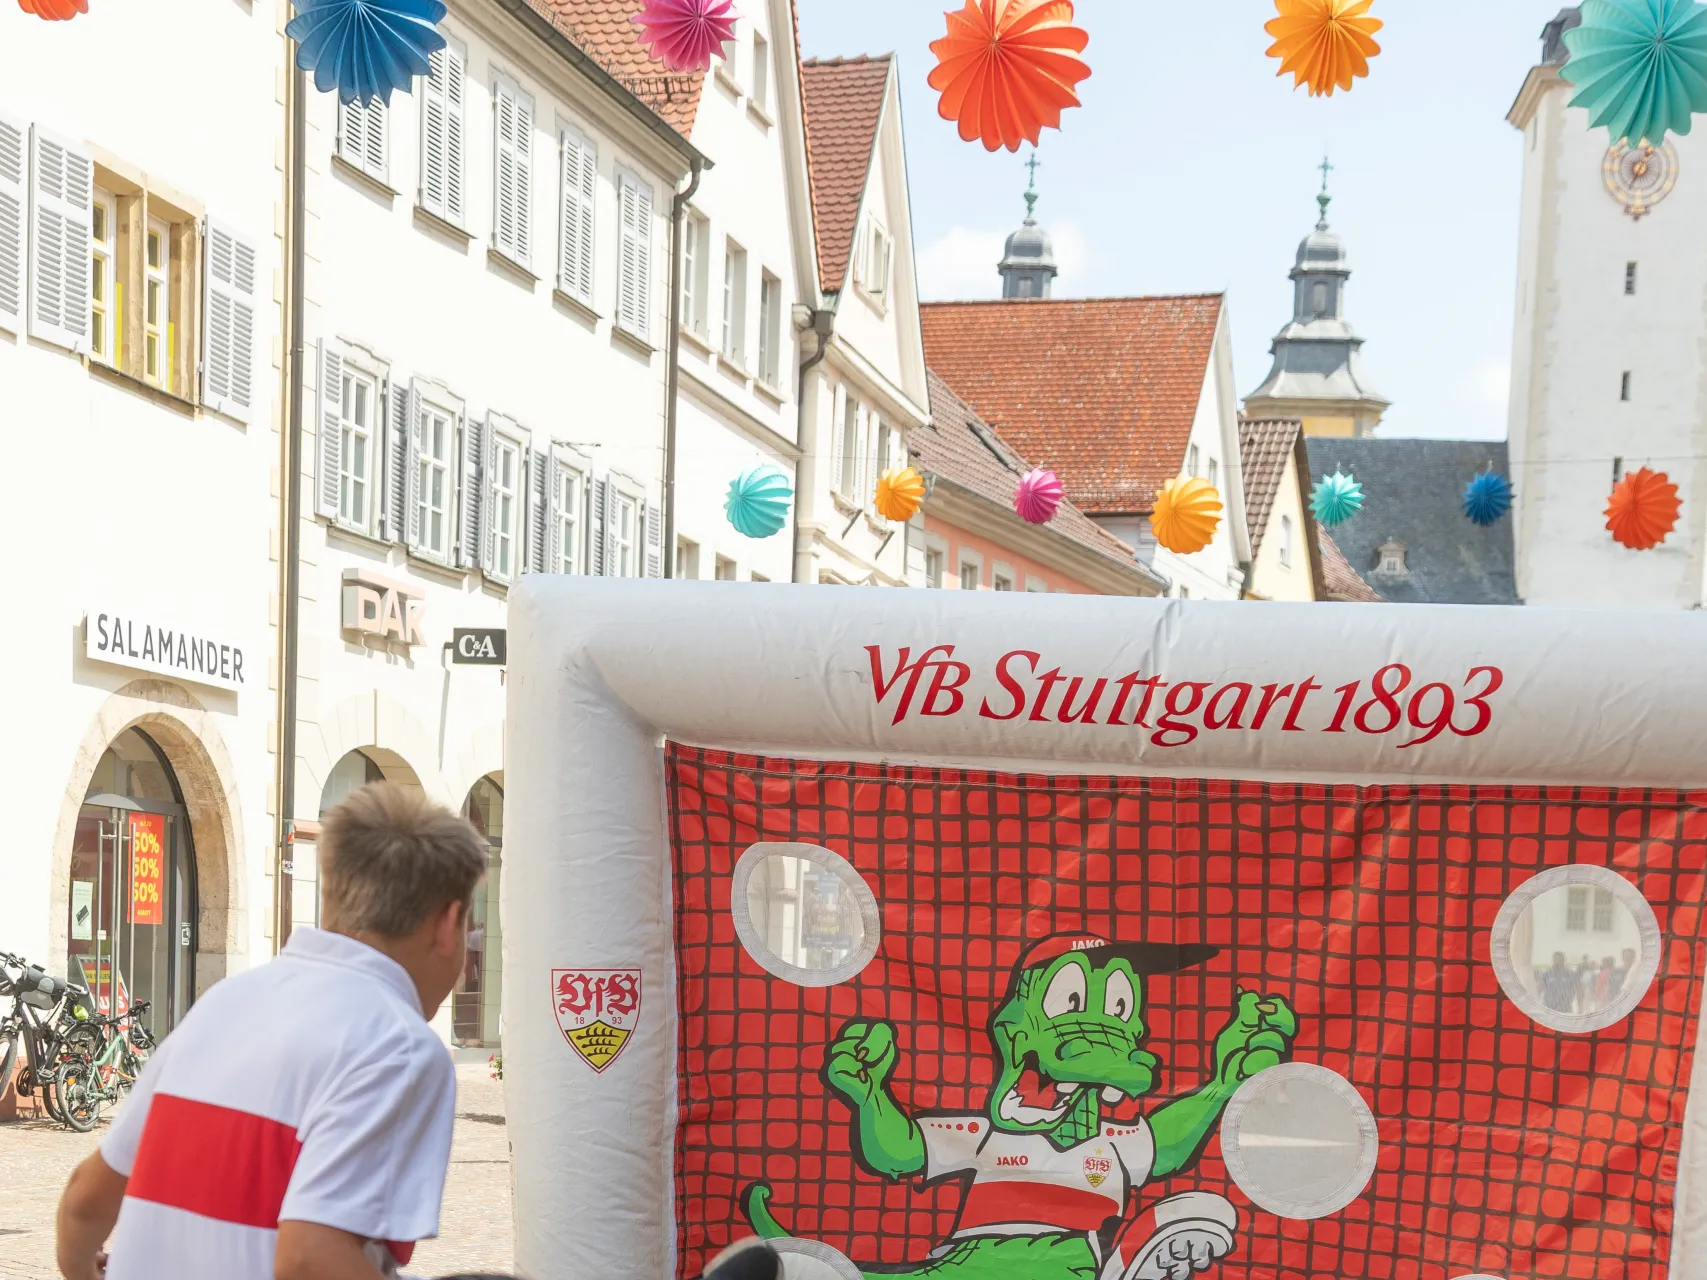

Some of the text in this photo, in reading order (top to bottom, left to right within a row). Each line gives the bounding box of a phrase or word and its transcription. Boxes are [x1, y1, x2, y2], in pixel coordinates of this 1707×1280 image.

[350, 580, 427, 647] DAK
[97, 613, 244, 684] SALAMANDER
[458, 634, 497, 658] C&A
[863, 644, 1504, 749] VfB Stuttgart 1893
[1070, 938, 1106, 951] JAKO
[556, 973, 639, 1018] VfB
[574, 1016, 622, 1025] 18 93
[996, 1155, 1029, 1166] JAKO
